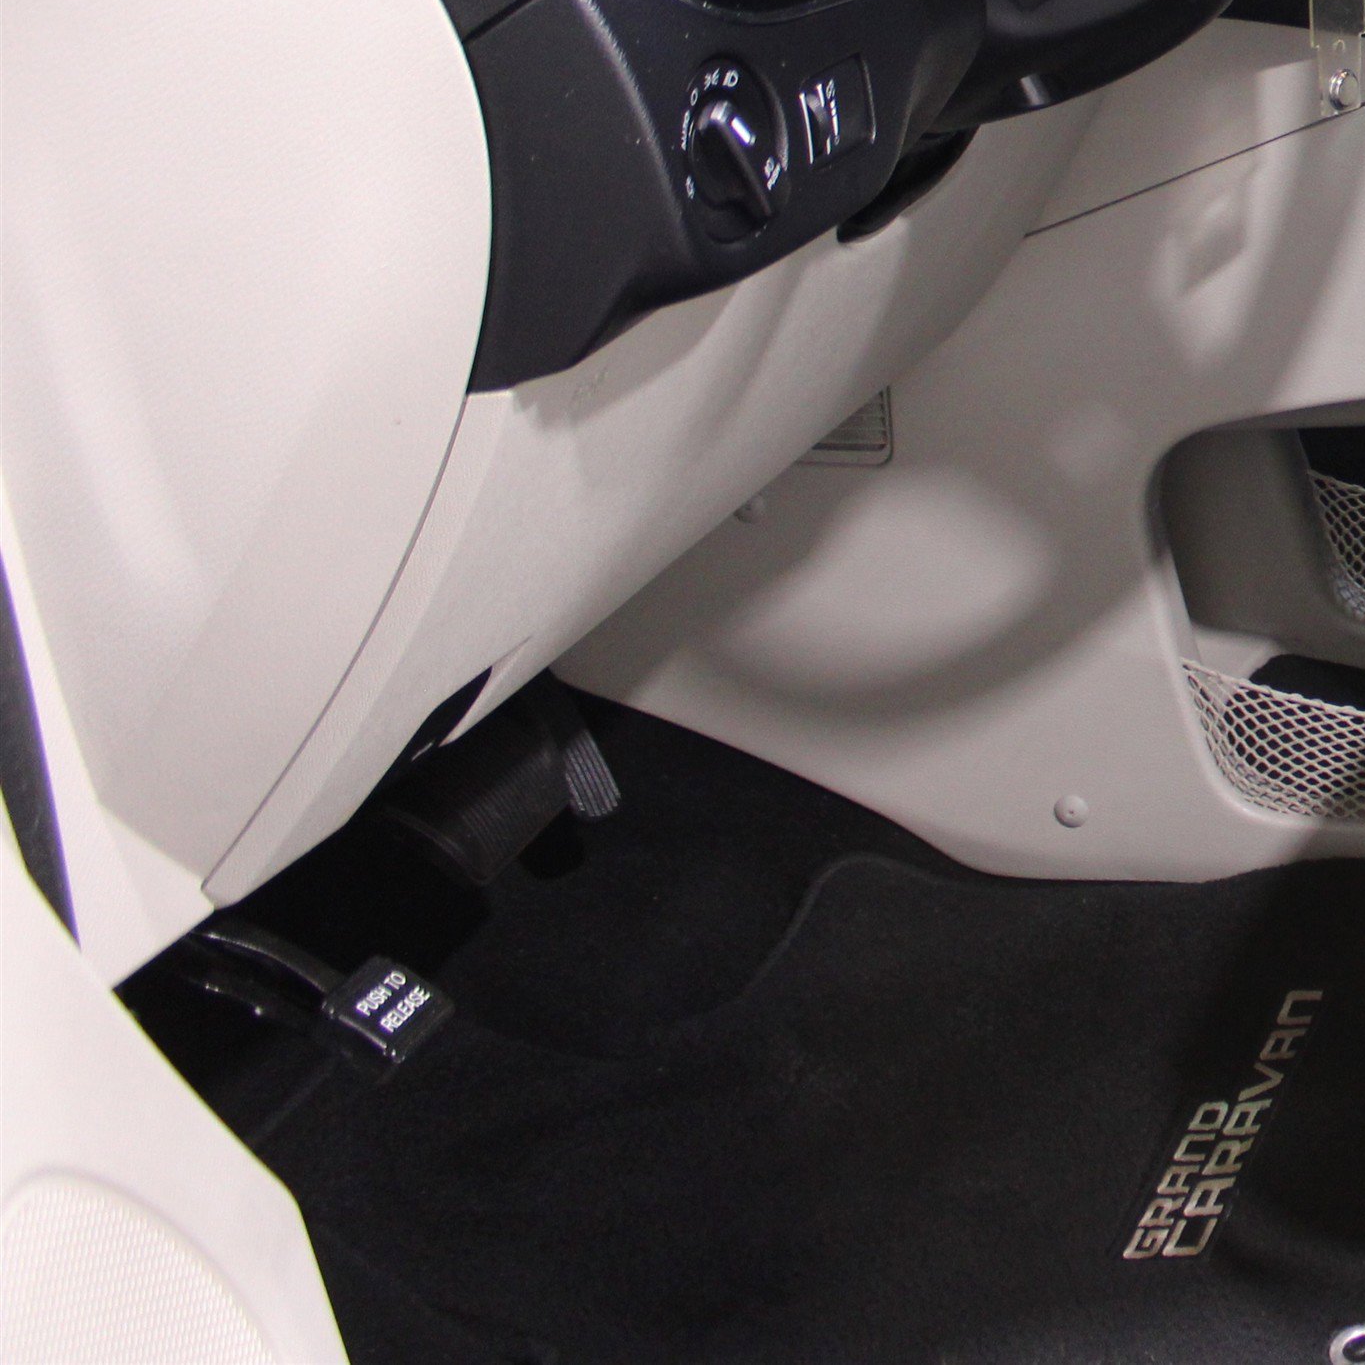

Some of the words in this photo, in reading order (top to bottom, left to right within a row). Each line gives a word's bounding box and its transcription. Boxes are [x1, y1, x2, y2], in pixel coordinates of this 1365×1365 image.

[357, 984, 391, 1015] PUSH
[384, 971, 406, 989] TO
[381, 986, 430, 1032] RELEASE
[1163, 990, 1323, 1257] CARAVAN
[1123, 1100, 1228, 1259] GRAND
